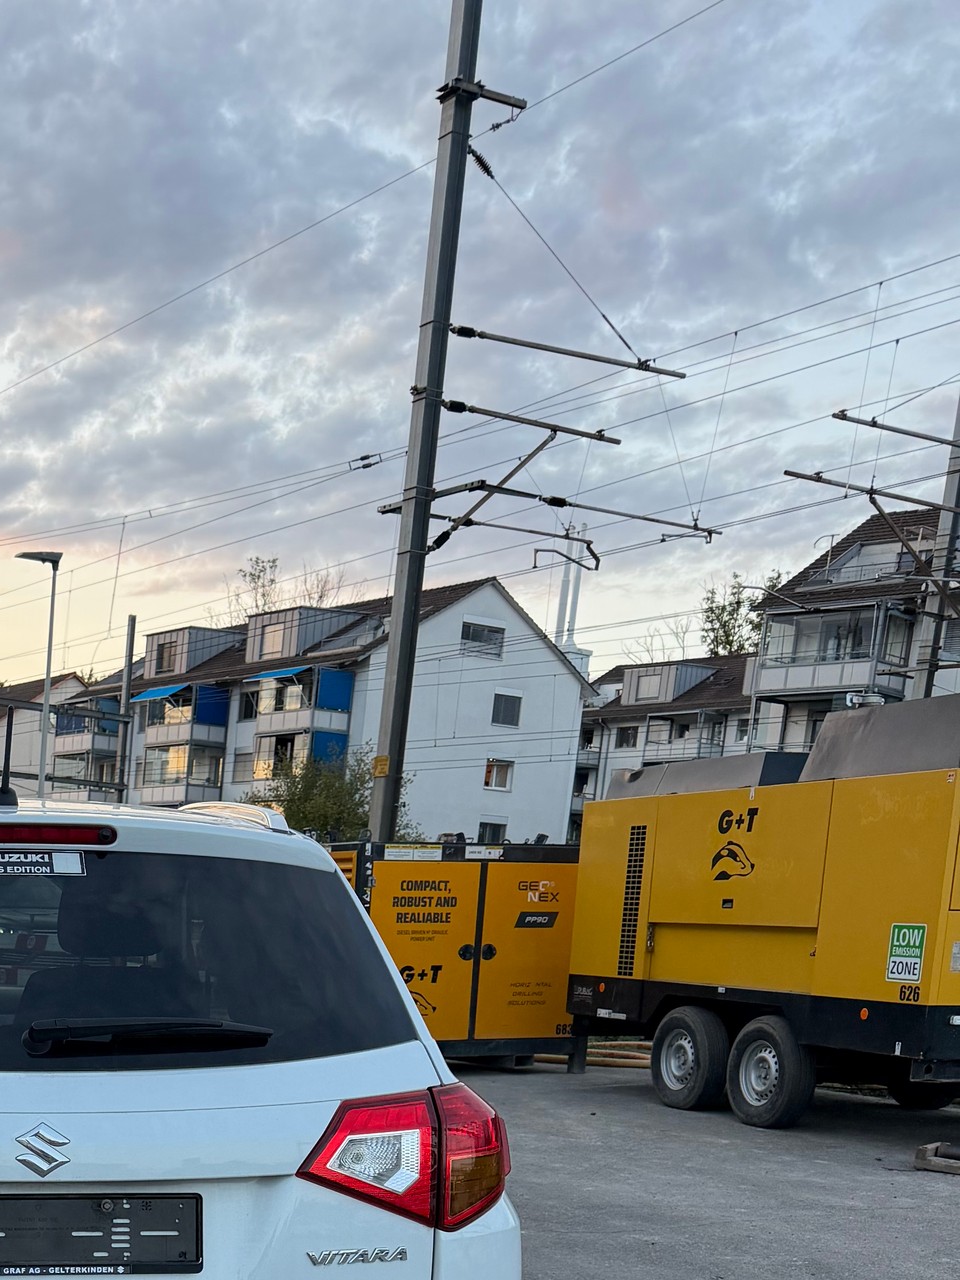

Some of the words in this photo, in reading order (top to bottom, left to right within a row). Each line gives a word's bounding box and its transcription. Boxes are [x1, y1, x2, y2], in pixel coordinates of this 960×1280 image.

[718, 807, 759, 834] G+T
[400, 880, 451, 893] COMPACT,
[392, 896, 434, 908] ROBUST
[434, 896, 458, 908] AND
[527, 891, 559, 902] NEX
[396, 912, 451, 924] REALIABLE
[893, 928, 923, 946] LOW
[892, 946, 921, 956] EMISSION
[400, 964, 443, 984] G+T
[890, 960, 919, 976] ZONE
[899, 984, 921, 1002] 626
[306, 1246, 407, 1266] VITARA
[3, 1267, 26, 1275] GRAF
[48, 1266, 114, 1274] GELTERKINDEN
